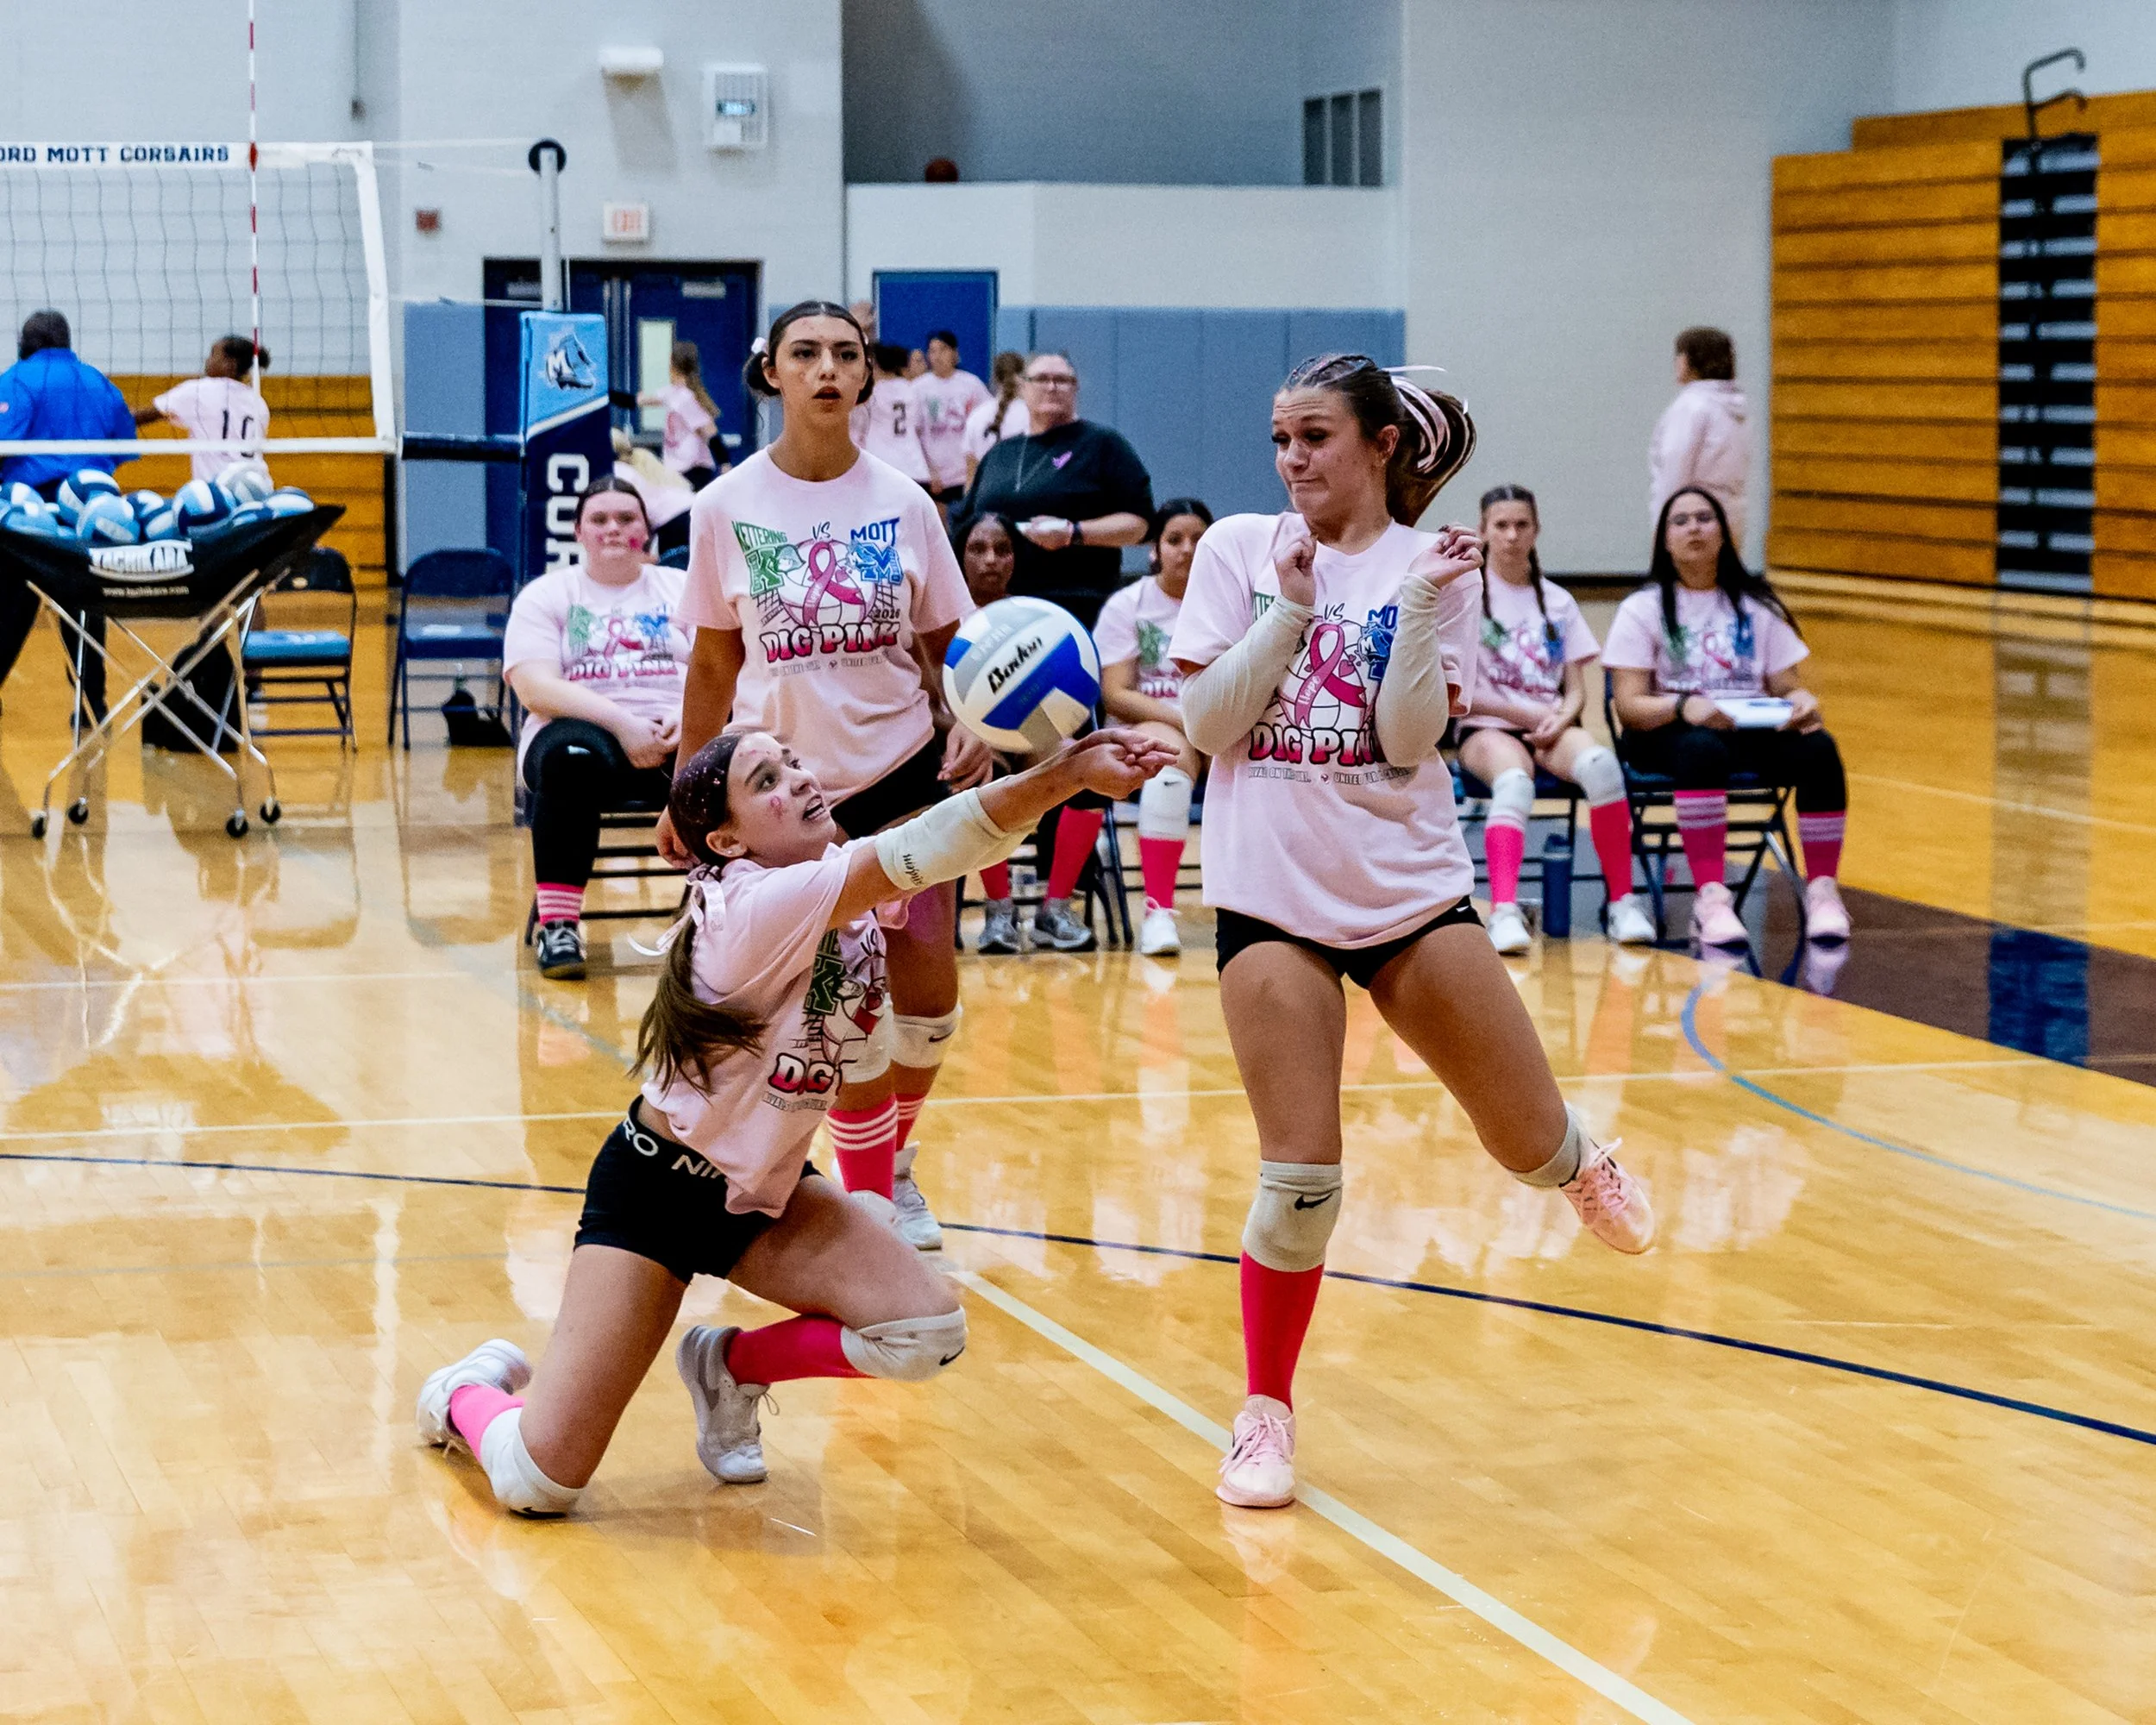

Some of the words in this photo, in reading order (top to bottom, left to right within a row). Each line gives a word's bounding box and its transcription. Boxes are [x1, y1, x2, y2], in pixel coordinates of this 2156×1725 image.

[47, 147, 110, 163] MOTT
[120, 147, 229, 163] CORSAIRS
[893, 400, 906, 436] 2
[812, 521, 830, 540] VS
[851, 517, 900, 547] MOTT
[1324, 603, 1345, 620] VS
[1368, 605, 1398, 630] MO
[759, 625, 813, 663] DIG
[819, 621, 900, 654] PINK
[1248, 722, 1303, 764] DIG
[622, 1116, 659, 1157] RO
[671, 1154, 721, 1179] NI
